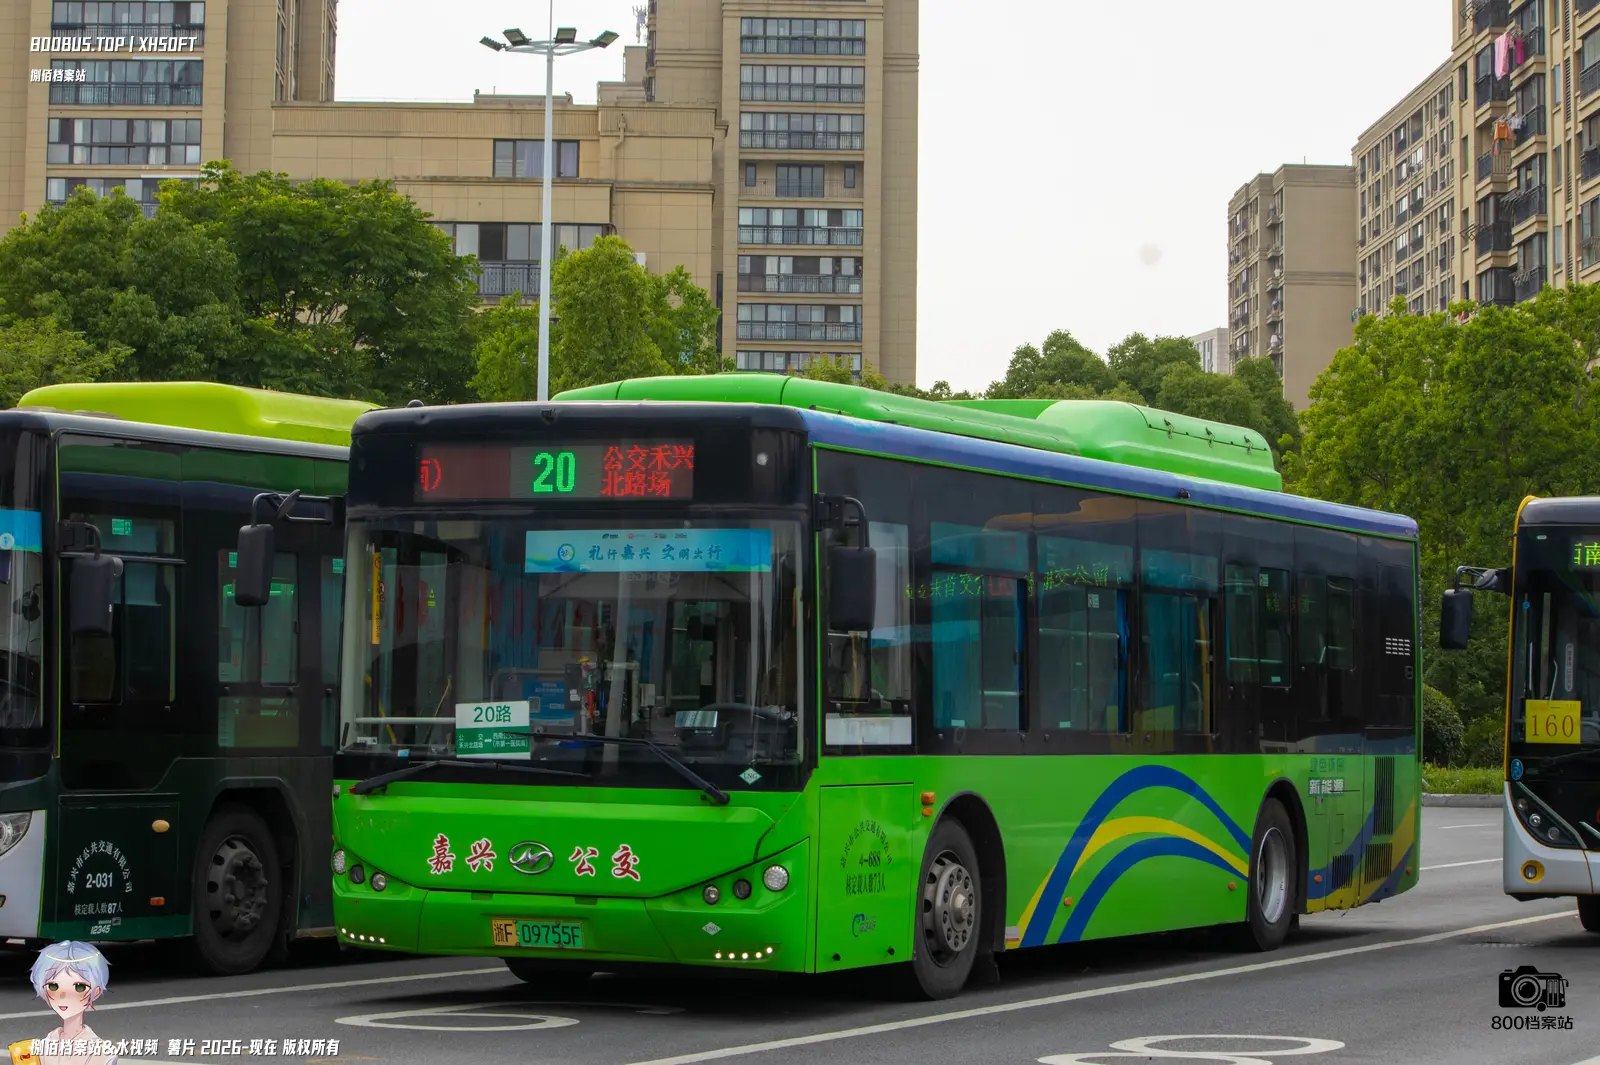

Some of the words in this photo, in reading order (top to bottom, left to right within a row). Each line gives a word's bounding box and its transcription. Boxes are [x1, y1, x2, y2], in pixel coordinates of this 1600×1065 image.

[602, 444, 695, 471] 公交禾兴
[533, 452, 576, 493] 20
[601, 471, 672, 497] 北路场
[473, 704, 512, 723] 20路
[1531, 714, 1575, 738] 160
[1308, 778, 1345, 796] 新能源
[427, 832, 497, 875] 嘉兴
[568, 843, 642, 882] 公交
[86, 872, 113, 889] 2-031
[74, 901, 123, 916] 核定载人数87人
[90, 924, 112, 935] 12345
